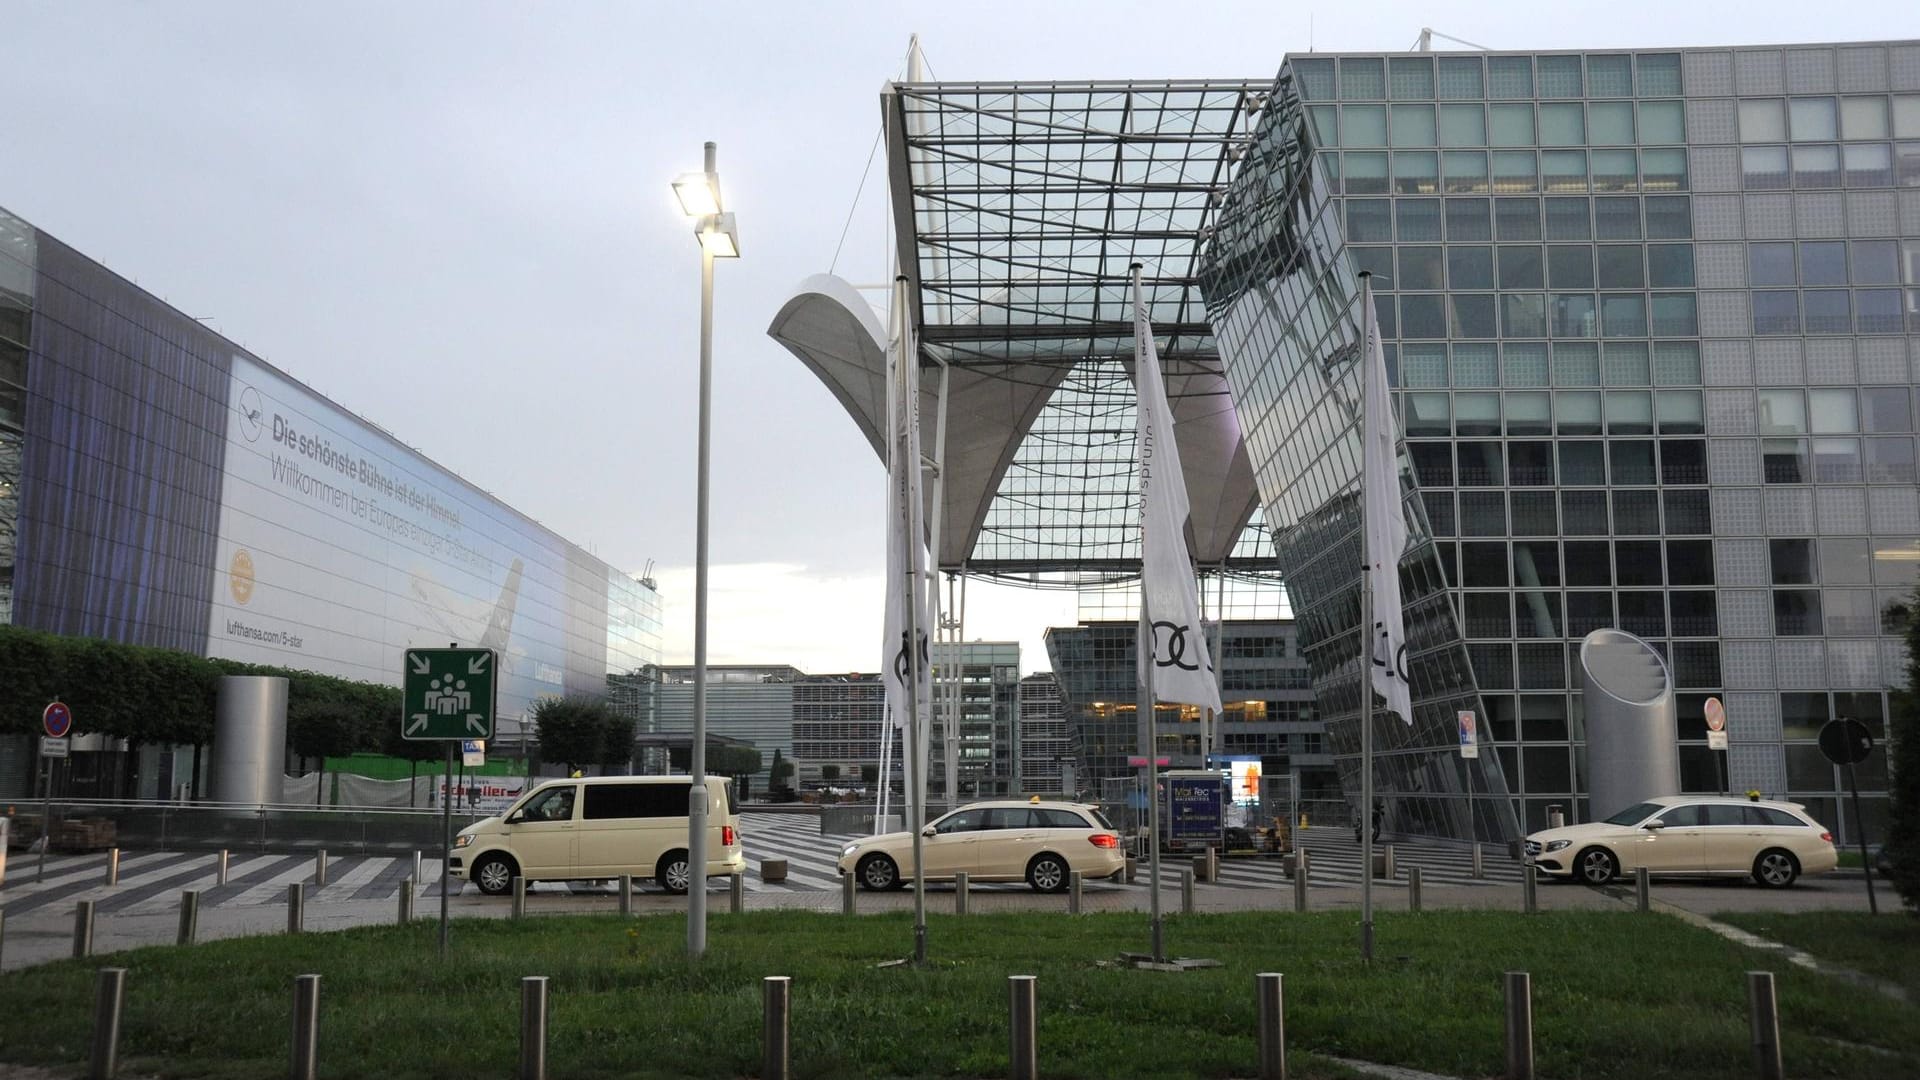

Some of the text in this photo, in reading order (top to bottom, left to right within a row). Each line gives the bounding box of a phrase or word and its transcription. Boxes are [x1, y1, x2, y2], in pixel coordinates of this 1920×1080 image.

[271, 450, 349, 512] Willkommen
[350, 489, 368, 522] bei
[273, 413, 297, 450] Die
[298, 434, 357, 480] schönste
[359, 457, 394, 497] Bühne
[394, 477, 408, 504] ist
[408, 486, 425, 514] der
[226, 618, 304, 649] lufthansa.com/5-star
